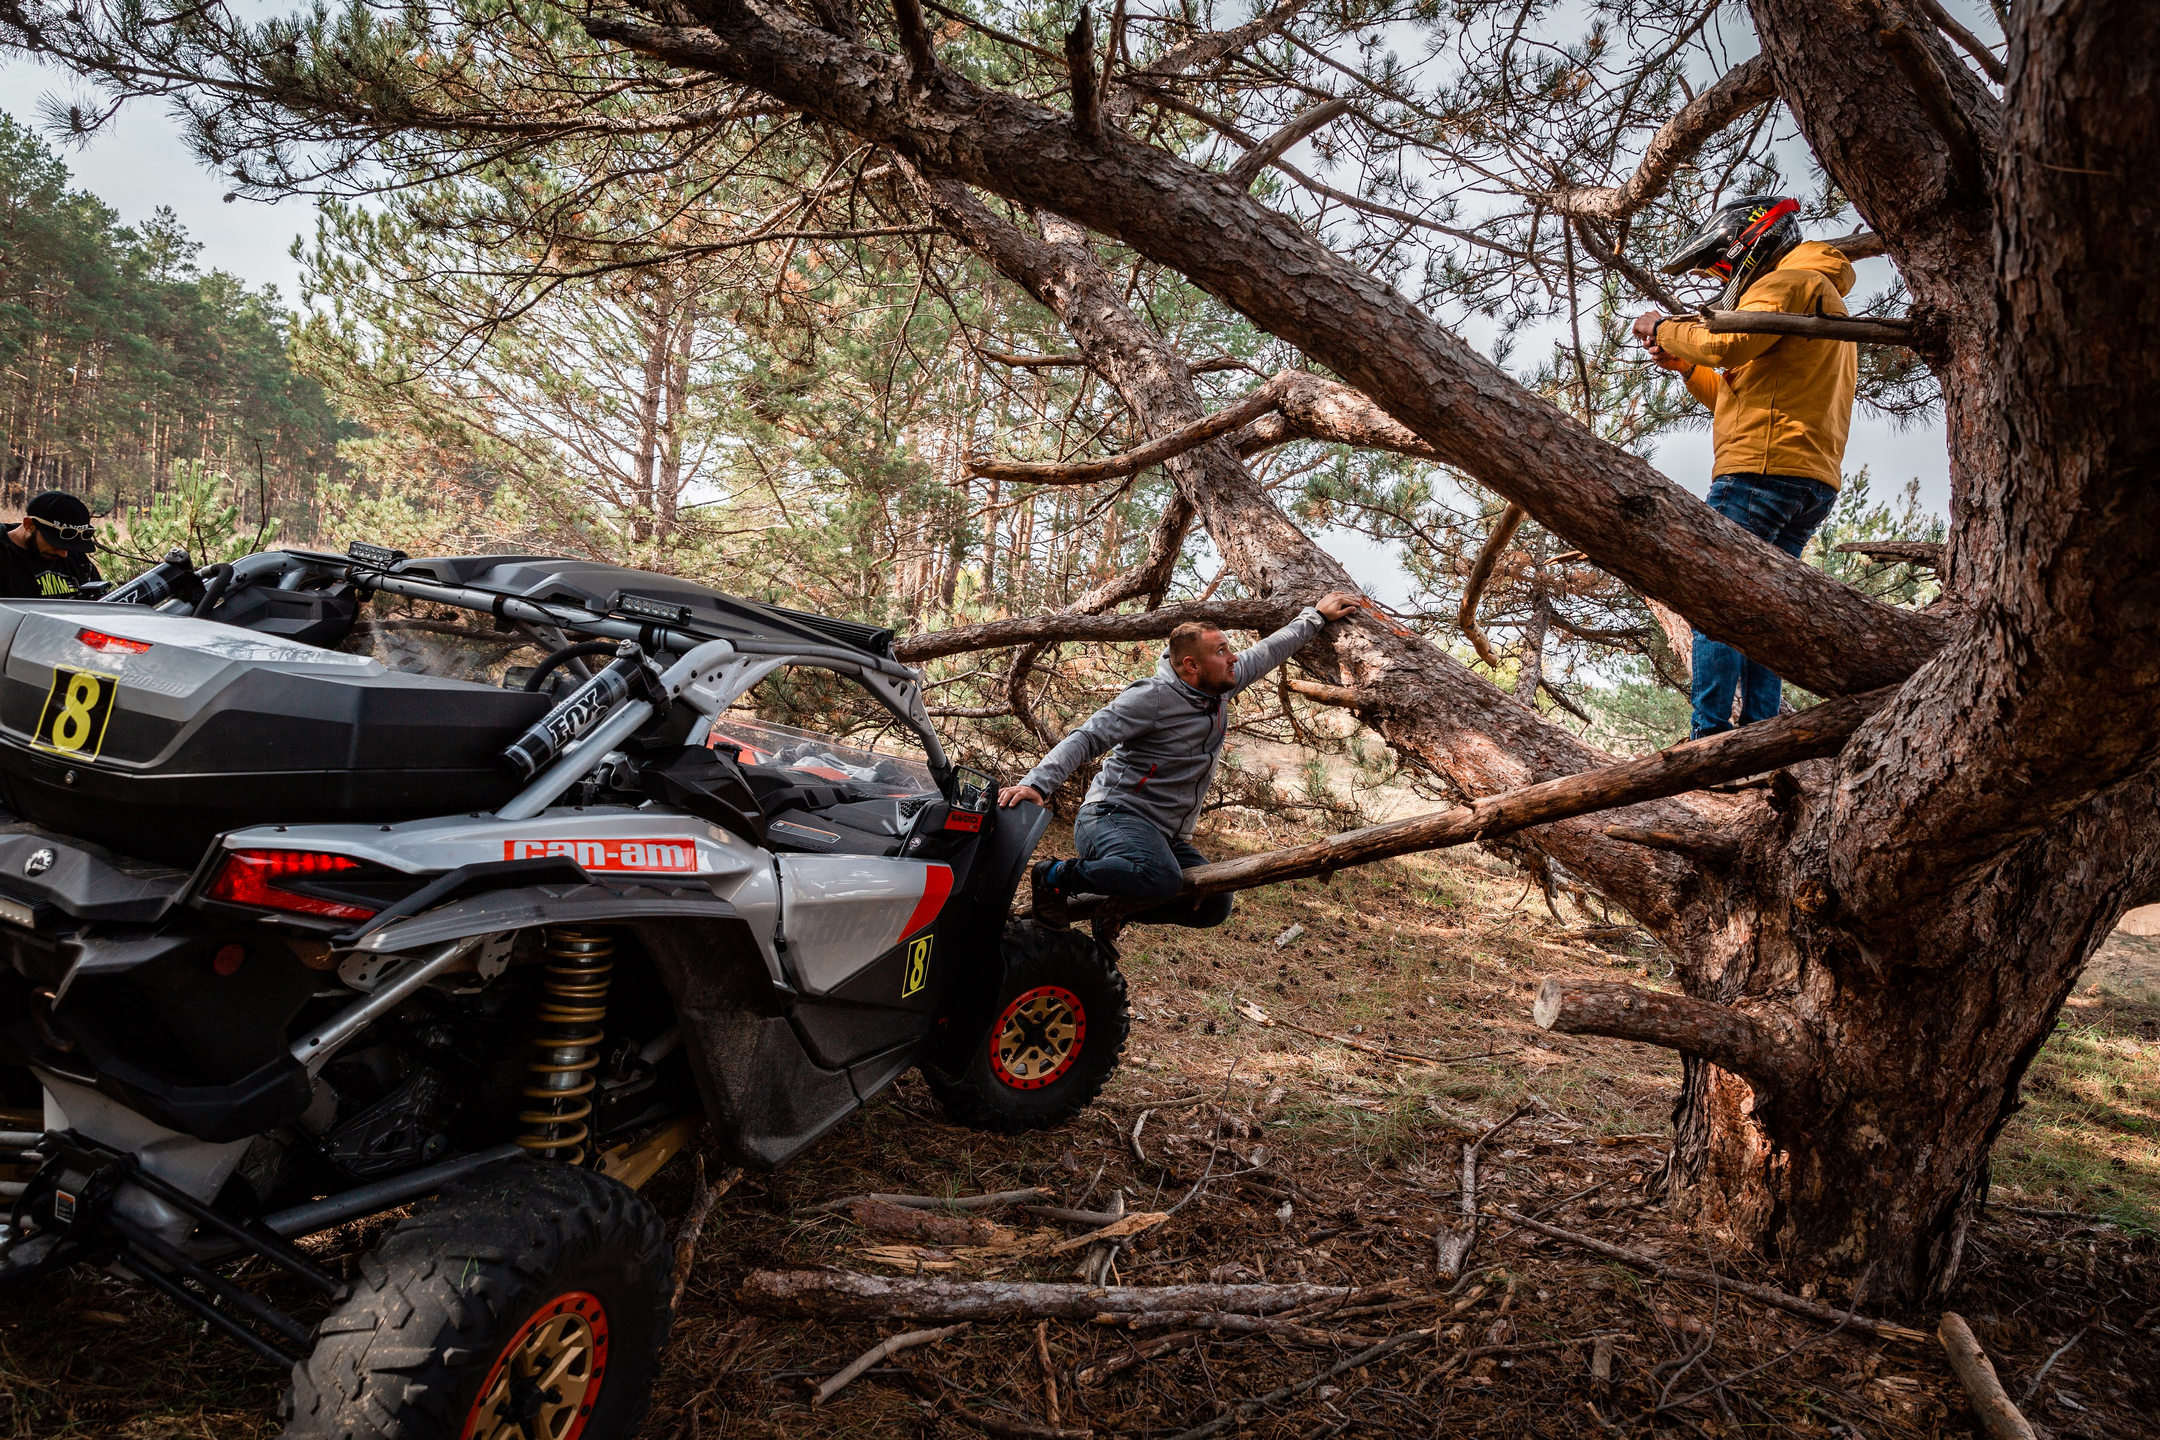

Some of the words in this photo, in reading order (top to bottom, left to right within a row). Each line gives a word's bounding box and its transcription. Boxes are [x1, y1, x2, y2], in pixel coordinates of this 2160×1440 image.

[52, 672, 100, 751] 8
[547, 688, 600, 749] FOX
[514, 842, 685, 867] can-am
[910, 939, 927, 991] 8
